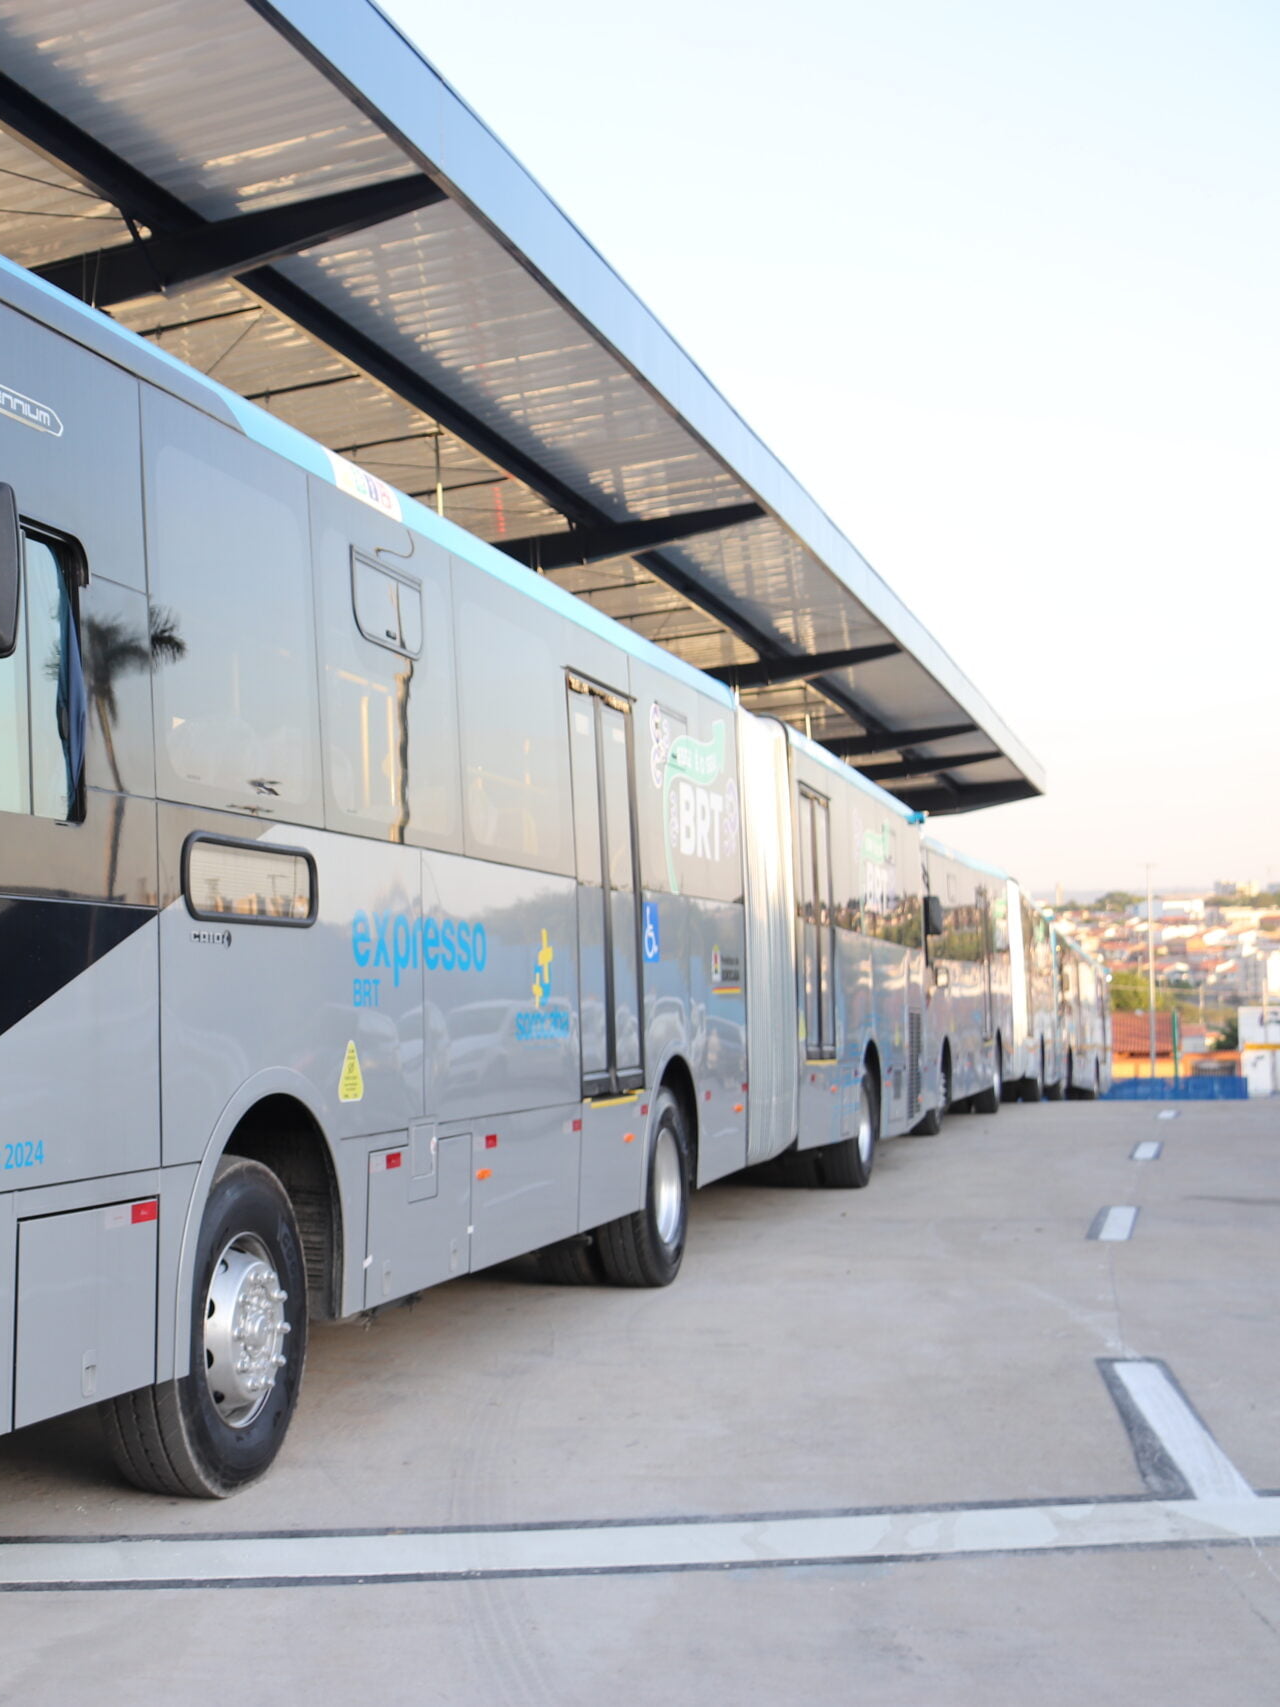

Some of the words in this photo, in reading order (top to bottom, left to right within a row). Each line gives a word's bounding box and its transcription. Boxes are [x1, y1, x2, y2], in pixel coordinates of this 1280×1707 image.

[679, 782, 723, 862] BRT
[191, 930, 222, 943] CAIO
[352, 909, 486, 987] expresso
[353, 978, 381, 1007] BRT
[4, 1139, 44, 1170] 2024
